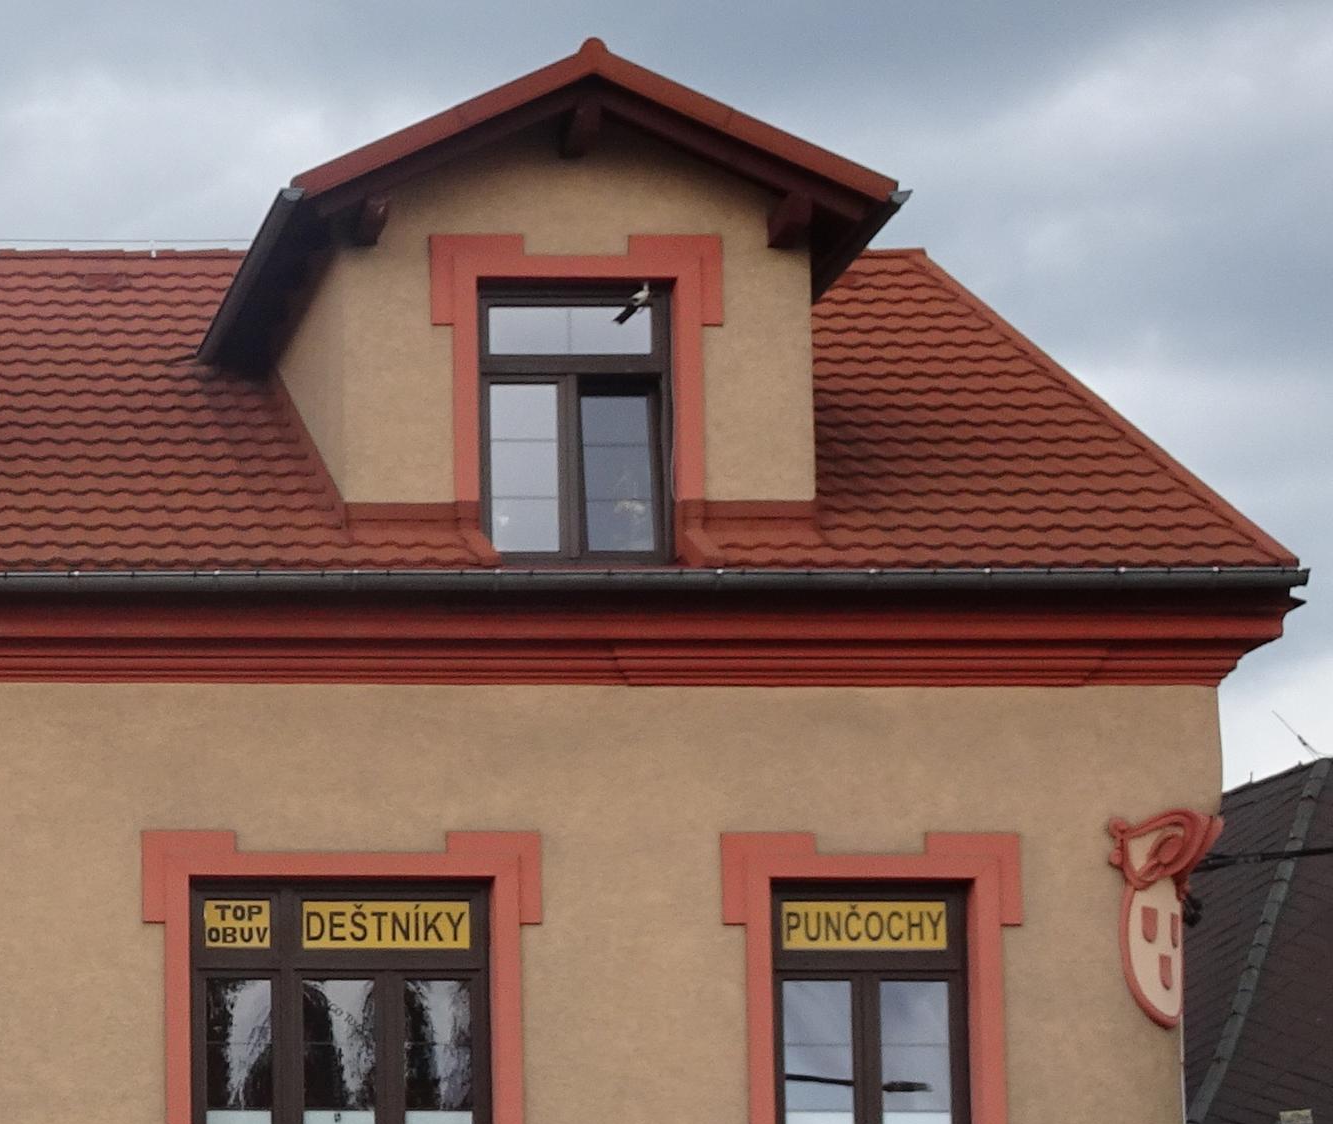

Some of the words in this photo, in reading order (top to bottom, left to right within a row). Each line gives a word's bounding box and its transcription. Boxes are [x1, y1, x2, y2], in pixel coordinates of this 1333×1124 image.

[215, 904, 262, 921] TOP
[306, 904, 466, 942] DEŠTNÍKY
[785, 904, 943, 942] PUNČOCHY
[207, 927, 268, 943] OBUV
